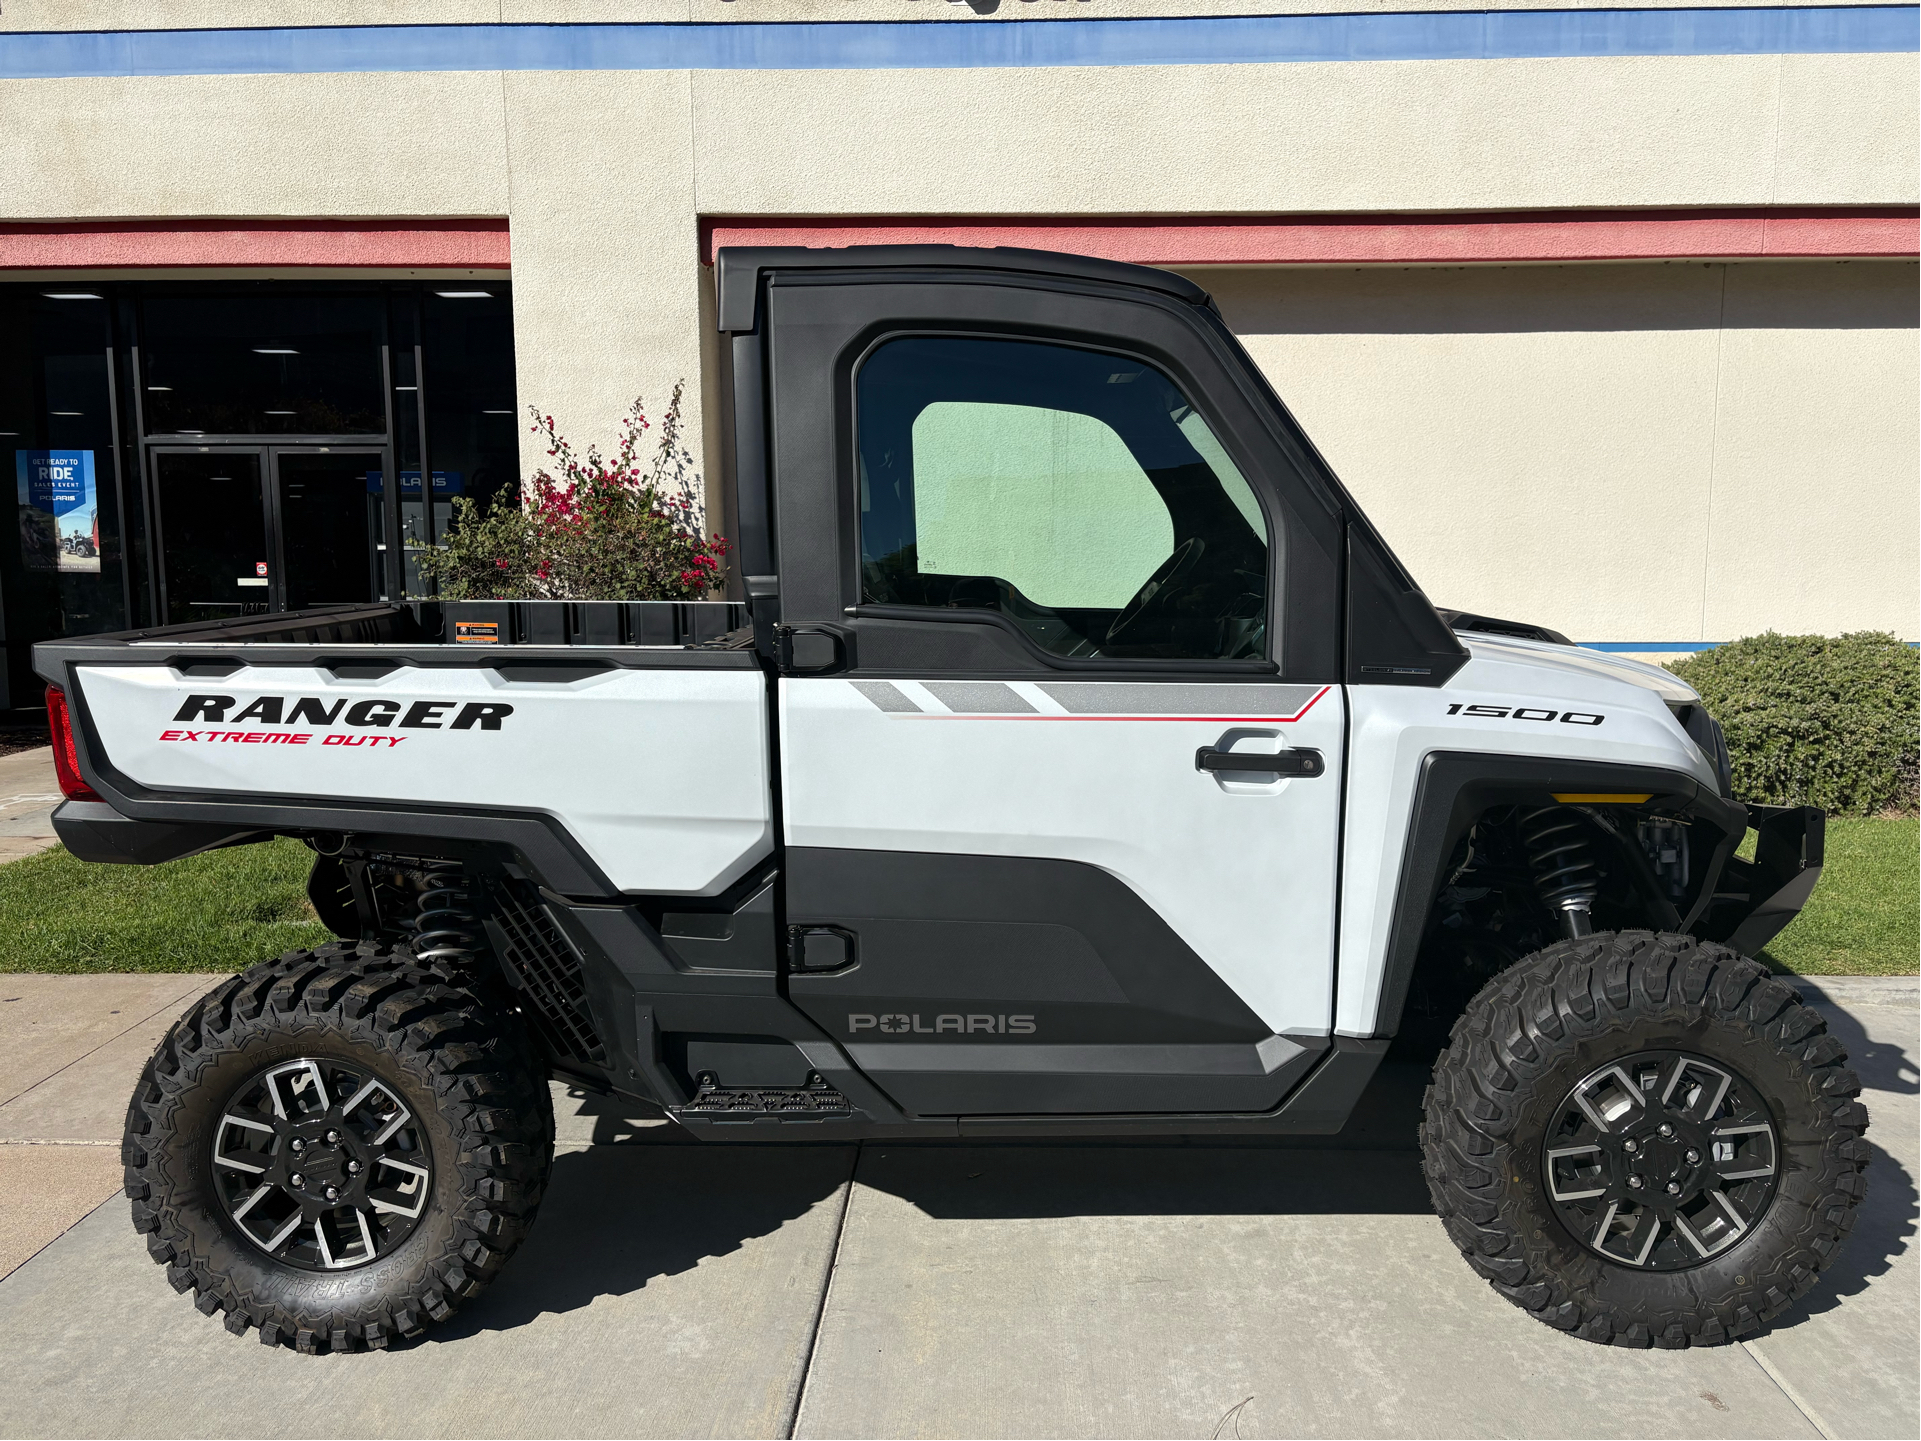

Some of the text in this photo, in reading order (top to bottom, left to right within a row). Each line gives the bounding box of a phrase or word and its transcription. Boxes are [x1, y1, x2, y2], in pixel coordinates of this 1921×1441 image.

[38, 466, 74, 481] RIDE
[380, 477, 447, 487] LAIS
[172, 694, 514, 731] RANGER
[1446, 703, 1605, 726] 1500
[159, 730, 408, 748] EXTREME DUTY
[848, 1014, 1037, 1034] POLARIS
[248, 1042, 331, 1069] KENDA
[268, 1235, 429, 1300] CROSS TRAIL
